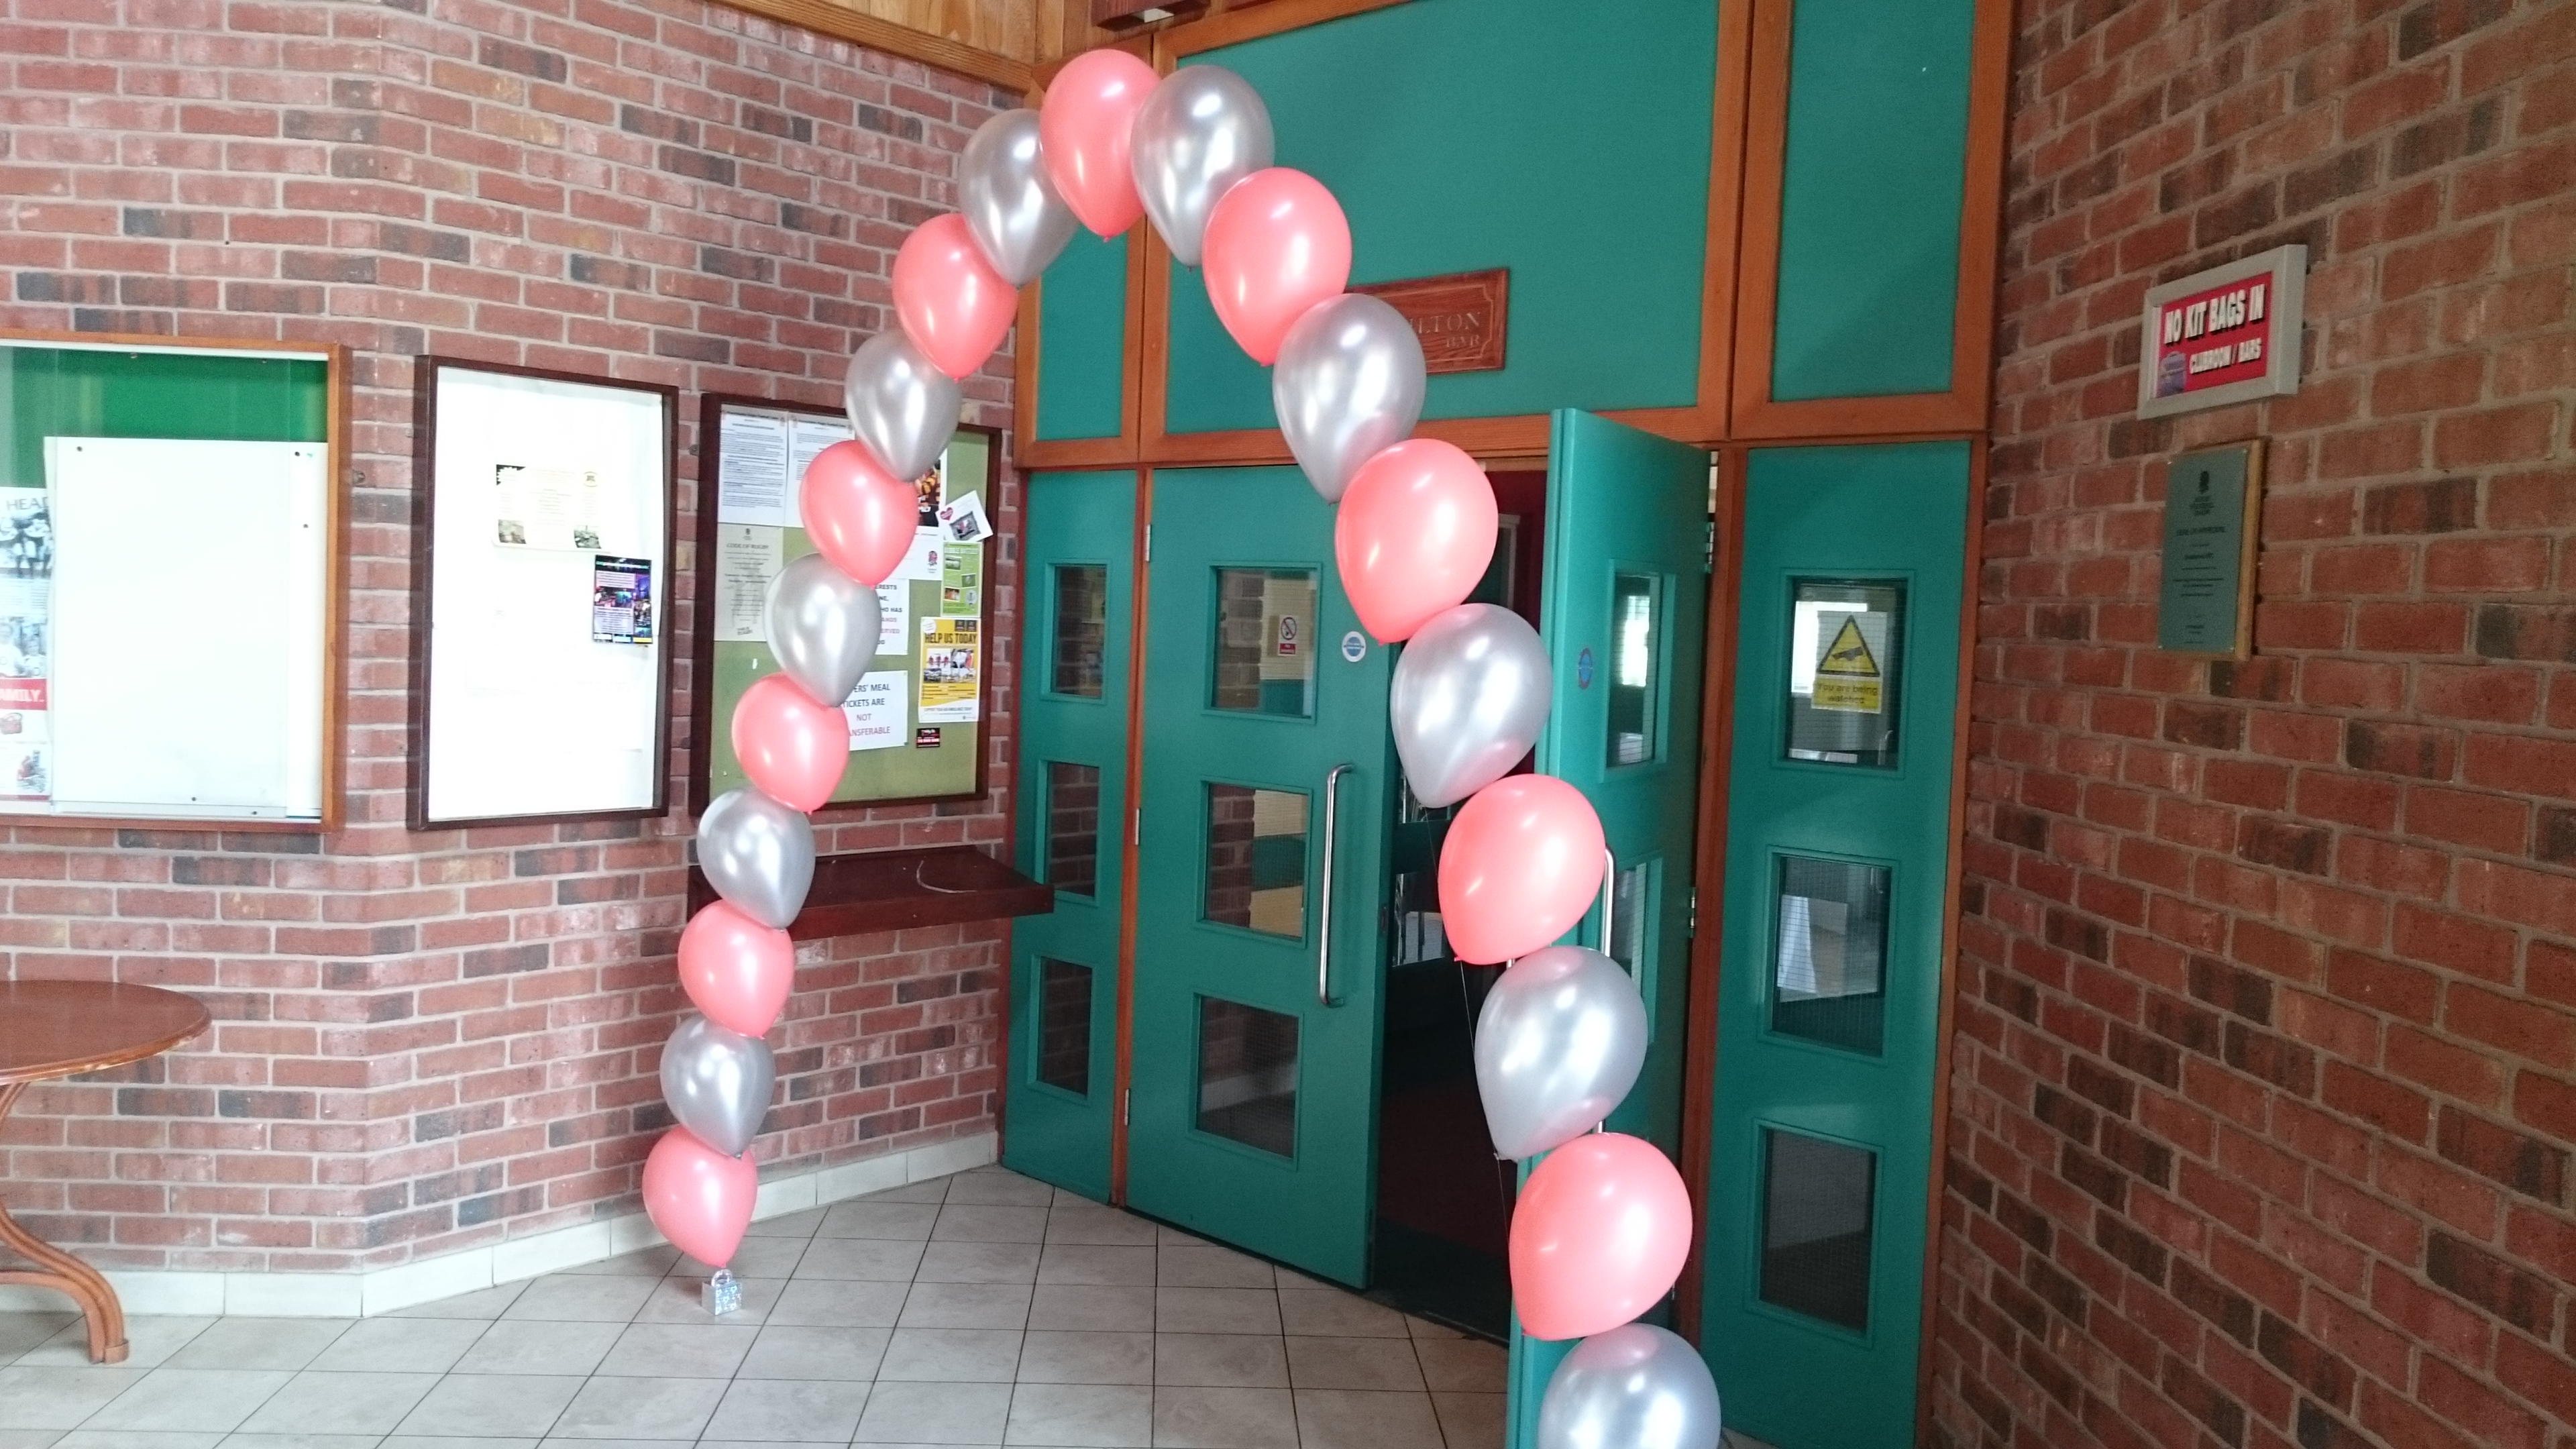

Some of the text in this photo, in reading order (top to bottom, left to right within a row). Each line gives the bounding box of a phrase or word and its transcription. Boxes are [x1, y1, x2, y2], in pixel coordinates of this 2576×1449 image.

[2164, 284, 2265, 344] NO KIT BAGS IN
[1446, 334, 1480, 347] BAR
[925, 633, 977, 644] HELP US TODAY
[871, 684, 890, 692] MEAL
[1818, 683, 1834, 692] You
[1852, 684, 1878, 696] being
[843, 699, 869, 708] TICKETS
[1828, 695, 1864, 704] watched
[856, 713, 872, 721] NOT
